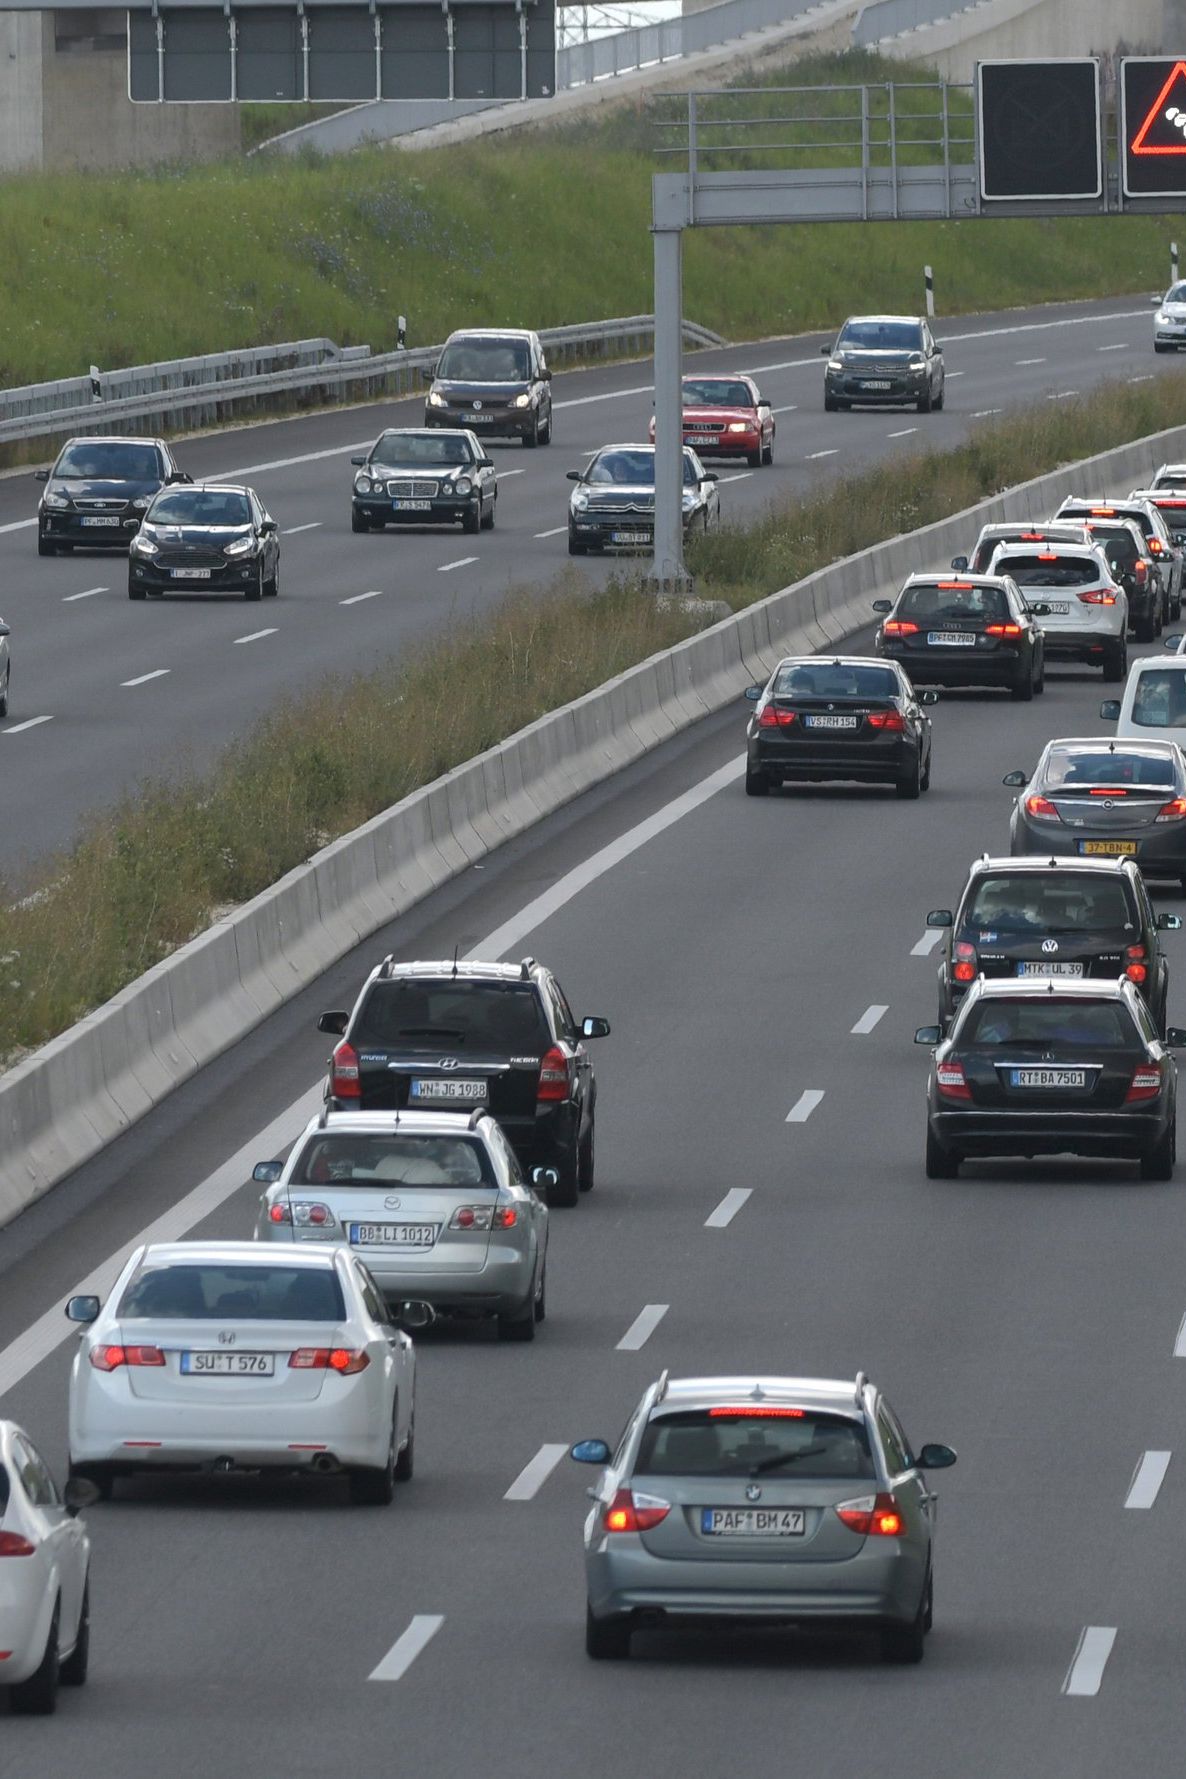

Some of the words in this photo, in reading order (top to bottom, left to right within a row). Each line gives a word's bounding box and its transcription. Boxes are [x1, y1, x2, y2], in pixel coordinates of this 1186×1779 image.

[1024, 964, 1044, 975] MTK
[1052, 964, 1066, 975] UL
[1069, 964, 1082, 975] 39
[1019, 1071, 1033, 1084] RT
[1040, 1072, 1055, 1084] BA
[1057, 1072, 1085, 1085] 7501
[419, 1083, 433, 1095] WN
[441, 1084, 455, 1096] JG
[457, 1084, 486, 1097] 1988
[360, 1227, 375, 1240] BB
[383, 1227, 398, 1241] LI
[401, 1227, 431, 1242] 1012
[195, 1355, 215, 1370] SU
[225, 1356, 234, 1370] T
[238, 1356, 267, 1371] 576
[713, 1512, 745, 1529] PAF
[756, 1513, 777, 1529] BM
[780, 1513, 802, 1529] 47
